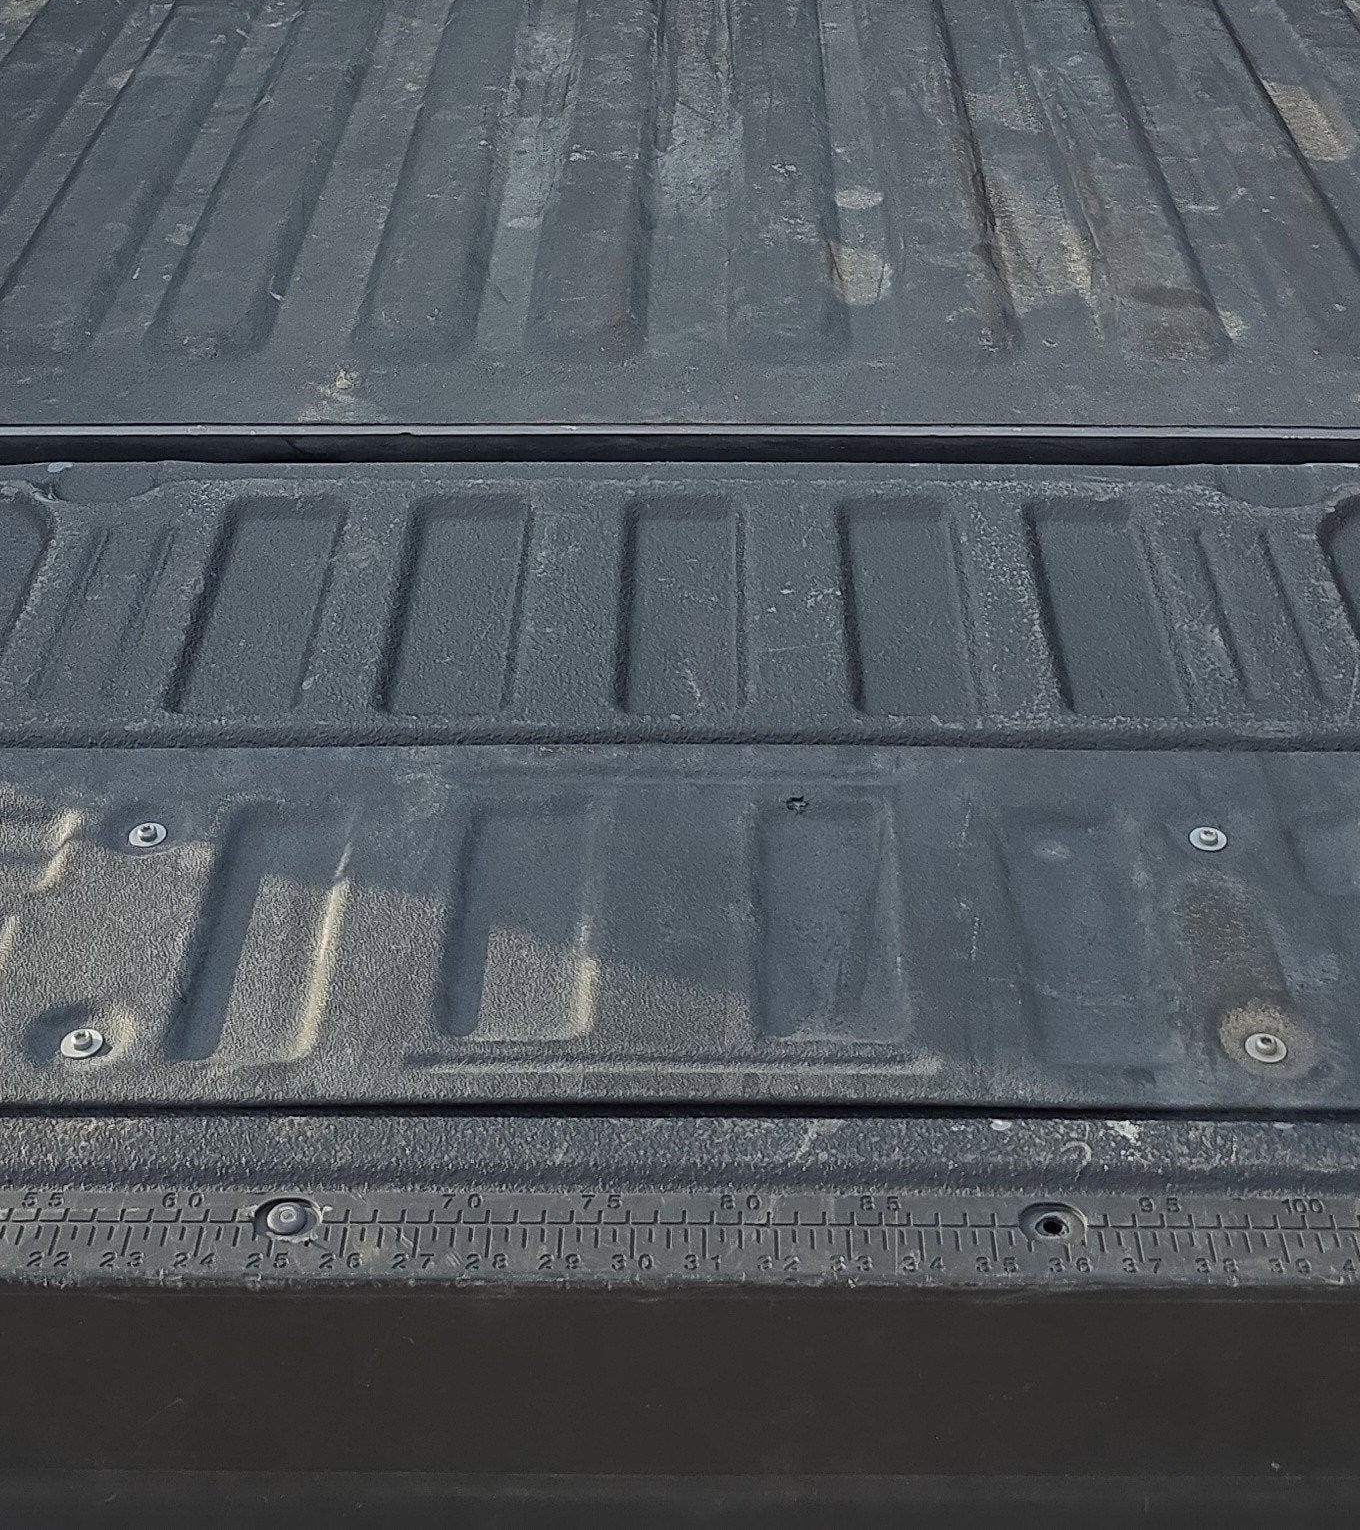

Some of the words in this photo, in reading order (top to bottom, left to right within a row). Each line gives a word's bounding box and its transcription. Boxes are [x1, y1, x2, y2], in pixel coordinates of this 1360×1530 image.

[22, 1192, 64, 1207] 55
[162, 1192, 204, 1208] 60
[442, 1193, 482, 1209] 70
[582, 1194, 622, 1210] 75
[720, 1194, 761, 1210] 80
[860, 1195, 901, 1210] 85
[1140, 1196, 1181, 1212] 95
[1282, 1197, 1323, 1213] 100
[28, 1251, 71, 1267] 22
[100, 1251, 144, 1268] 23
[174, 1252, 215, 1269] 24
[246, 1252, 289, 1269] 25
[319, 1252, 363, 1269] 26
[392, 1252, 434, 1269] 27
[465, 1252, 508, 1269] 28
[539, 1252, 581, 1270] 29
[611, 1253, 654, 1270] 30
[684, 1254, 721, 1271] 31
[758, 1254, 800, 1271] 32
[830, 1254, 873, 1271] 33
[902, 1255, 944, 1271] 34
[976, 1256, 1019, 1273] 35
[1049, 1256, 1091, 1273] 36
[1122, 1257, 1162, 1273] 37
[1195, 1257, 1239, 1273] 38
[1268, 1257, 1311, 1273] 39
